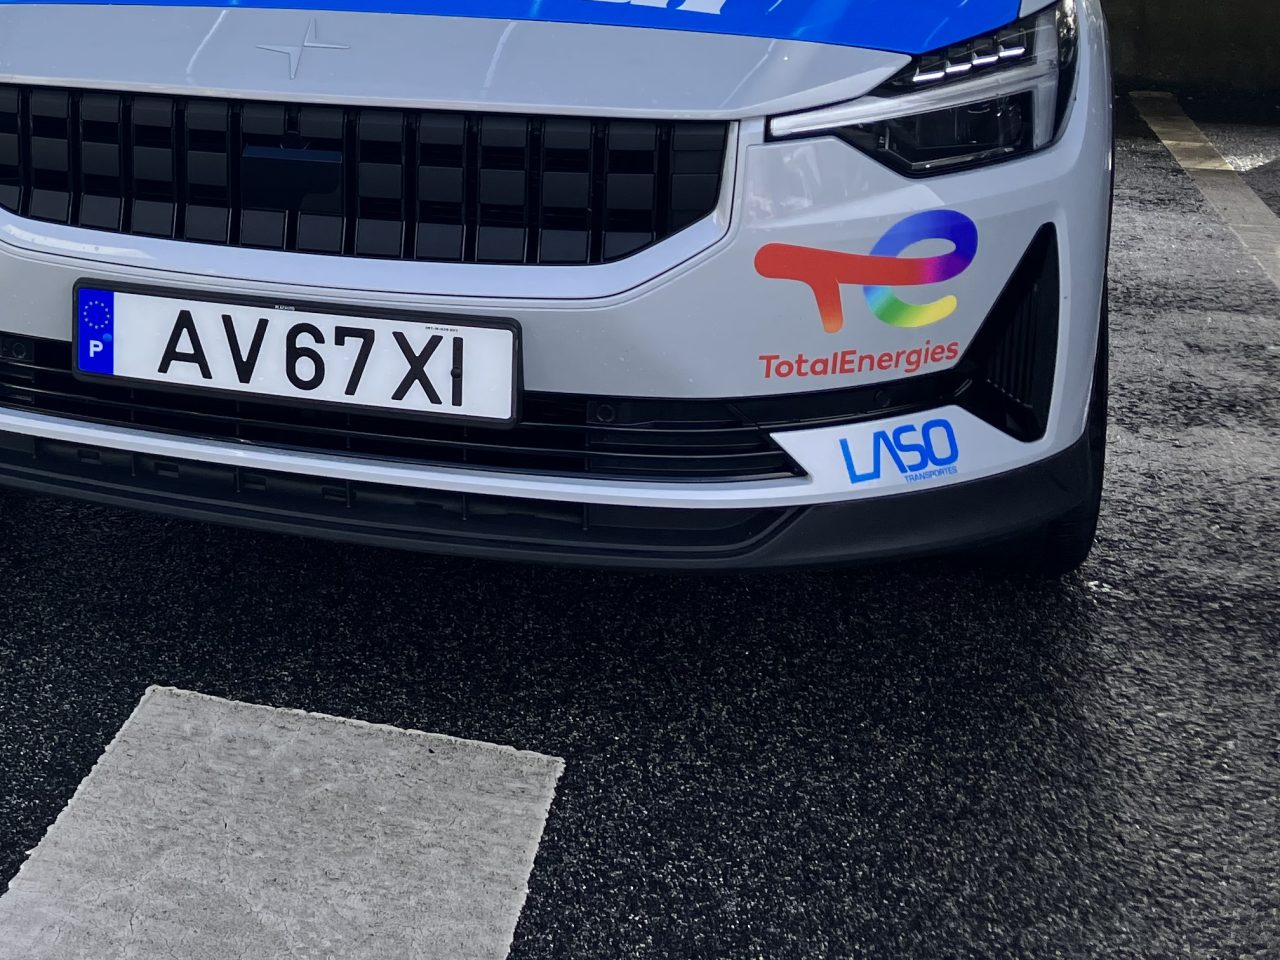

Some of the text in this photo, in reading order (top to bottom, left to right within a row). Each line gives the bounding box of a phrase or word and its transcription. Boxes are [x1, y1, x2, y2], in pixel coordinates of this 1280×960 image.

[88, 339, 104, 358] P
[758, 339, 960, 379] TotalEnergies
[838, 418, 960, 485] LASO
[904, 465, 958, 484] TRANSPORTES
